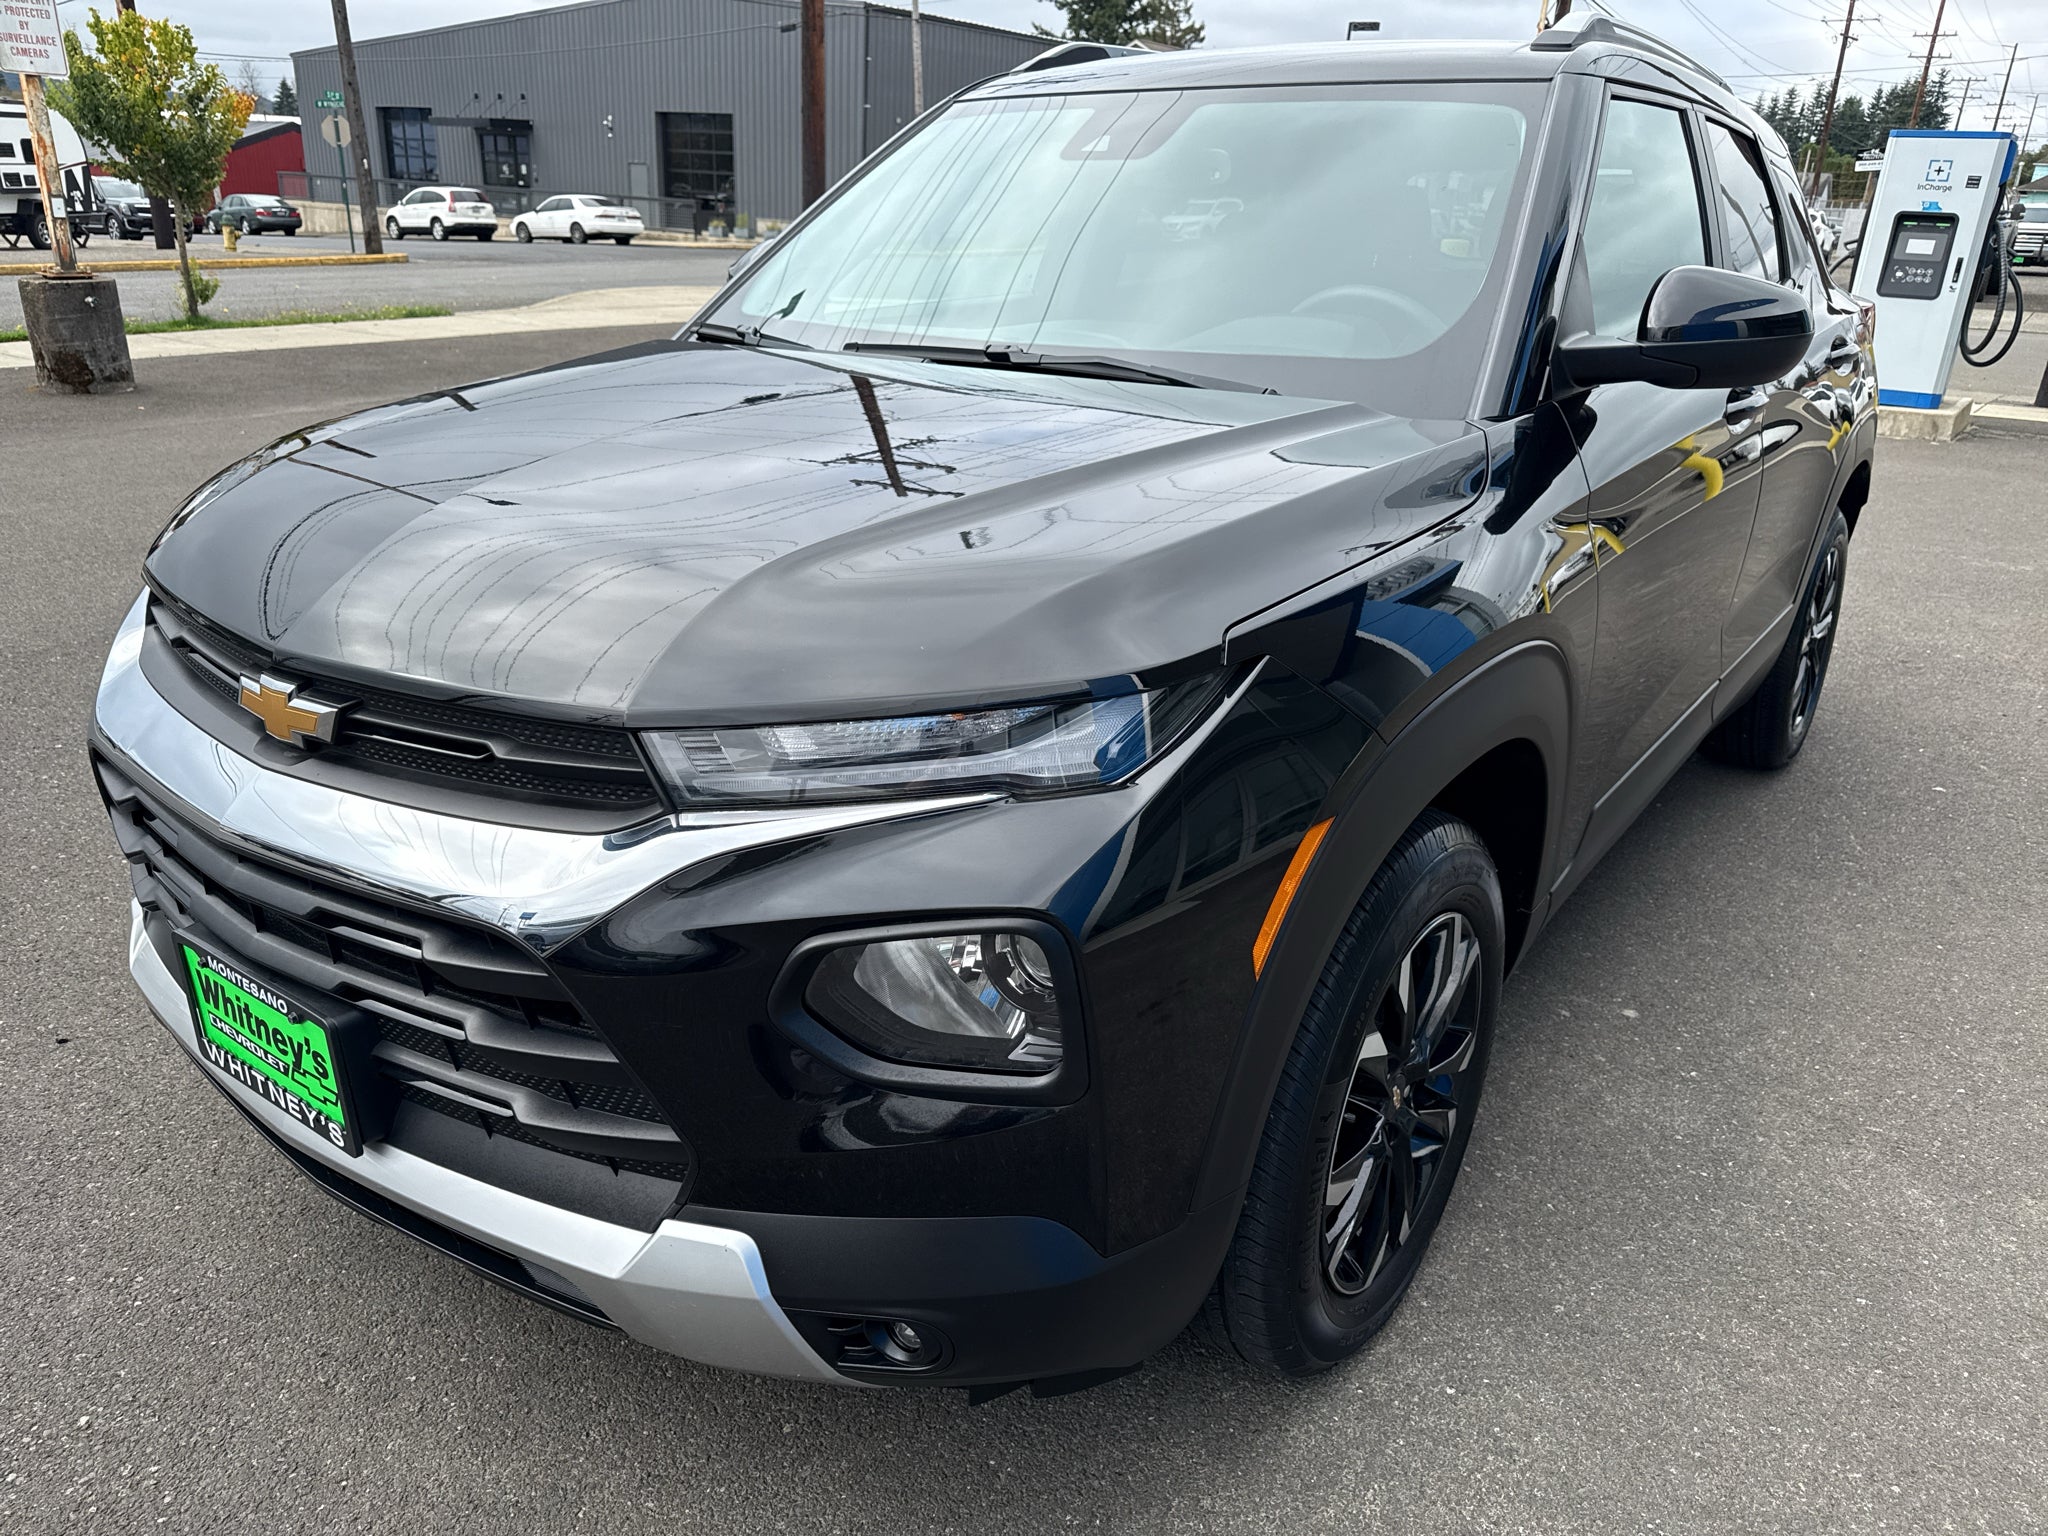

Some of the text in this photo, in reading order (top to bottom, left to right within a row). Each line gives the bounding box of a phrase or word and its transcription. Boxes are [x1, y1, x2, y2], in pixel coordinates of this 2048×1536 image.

[4, 5, 51, 20] PROTECTED
[19, 20, 29, 30] BY
[0, 32, 57, 46] SURVEILLANCE
[10, 46, 49, 59] CAMERAS
[1917, 183, 1953, 193] InCharge
[207, 955, 288, 1014] MONTESANO
[195, 967, 329, 1081] Whitney's
[209, 1013, 288, 1073] CHEVROLET
[202, 1038, 345, 1148] WHITNEY'S
